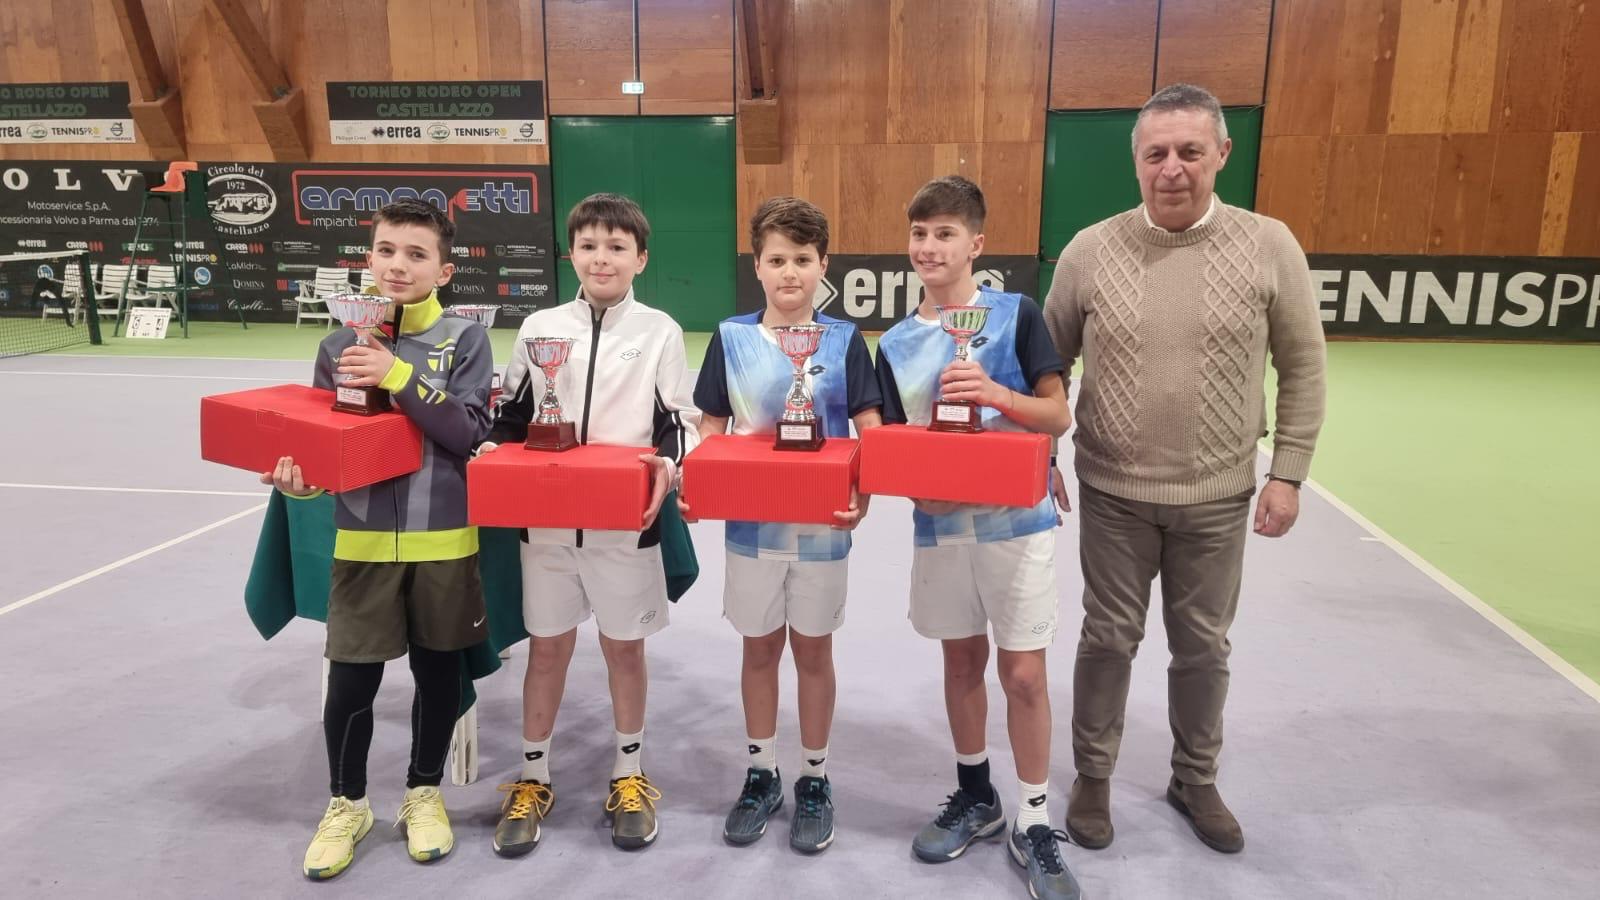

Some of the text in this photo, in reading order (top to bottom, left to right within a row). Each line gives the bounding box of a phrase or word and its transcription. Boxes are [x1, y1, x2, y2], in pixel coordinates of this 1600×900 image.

[15, 87, 65, 99] RODEO
[70, 86, 110, 98] OPEN
[347, 85, 521, 98] TORNEO RODEO OPEN
[376, 102, 495, 117] CASTELLAZZO
[207, 163, 264, 178] Circolo del
[226, 181, 246, 190] 1972
[27, 201, 111, 212] Motoservice S.p.A.
[54, 215, 79, 225] Volvo
[89, 216, 119, 226] Parma
[122, 216, 137, 226] dal
[313, 215, 357, 230] impianti
